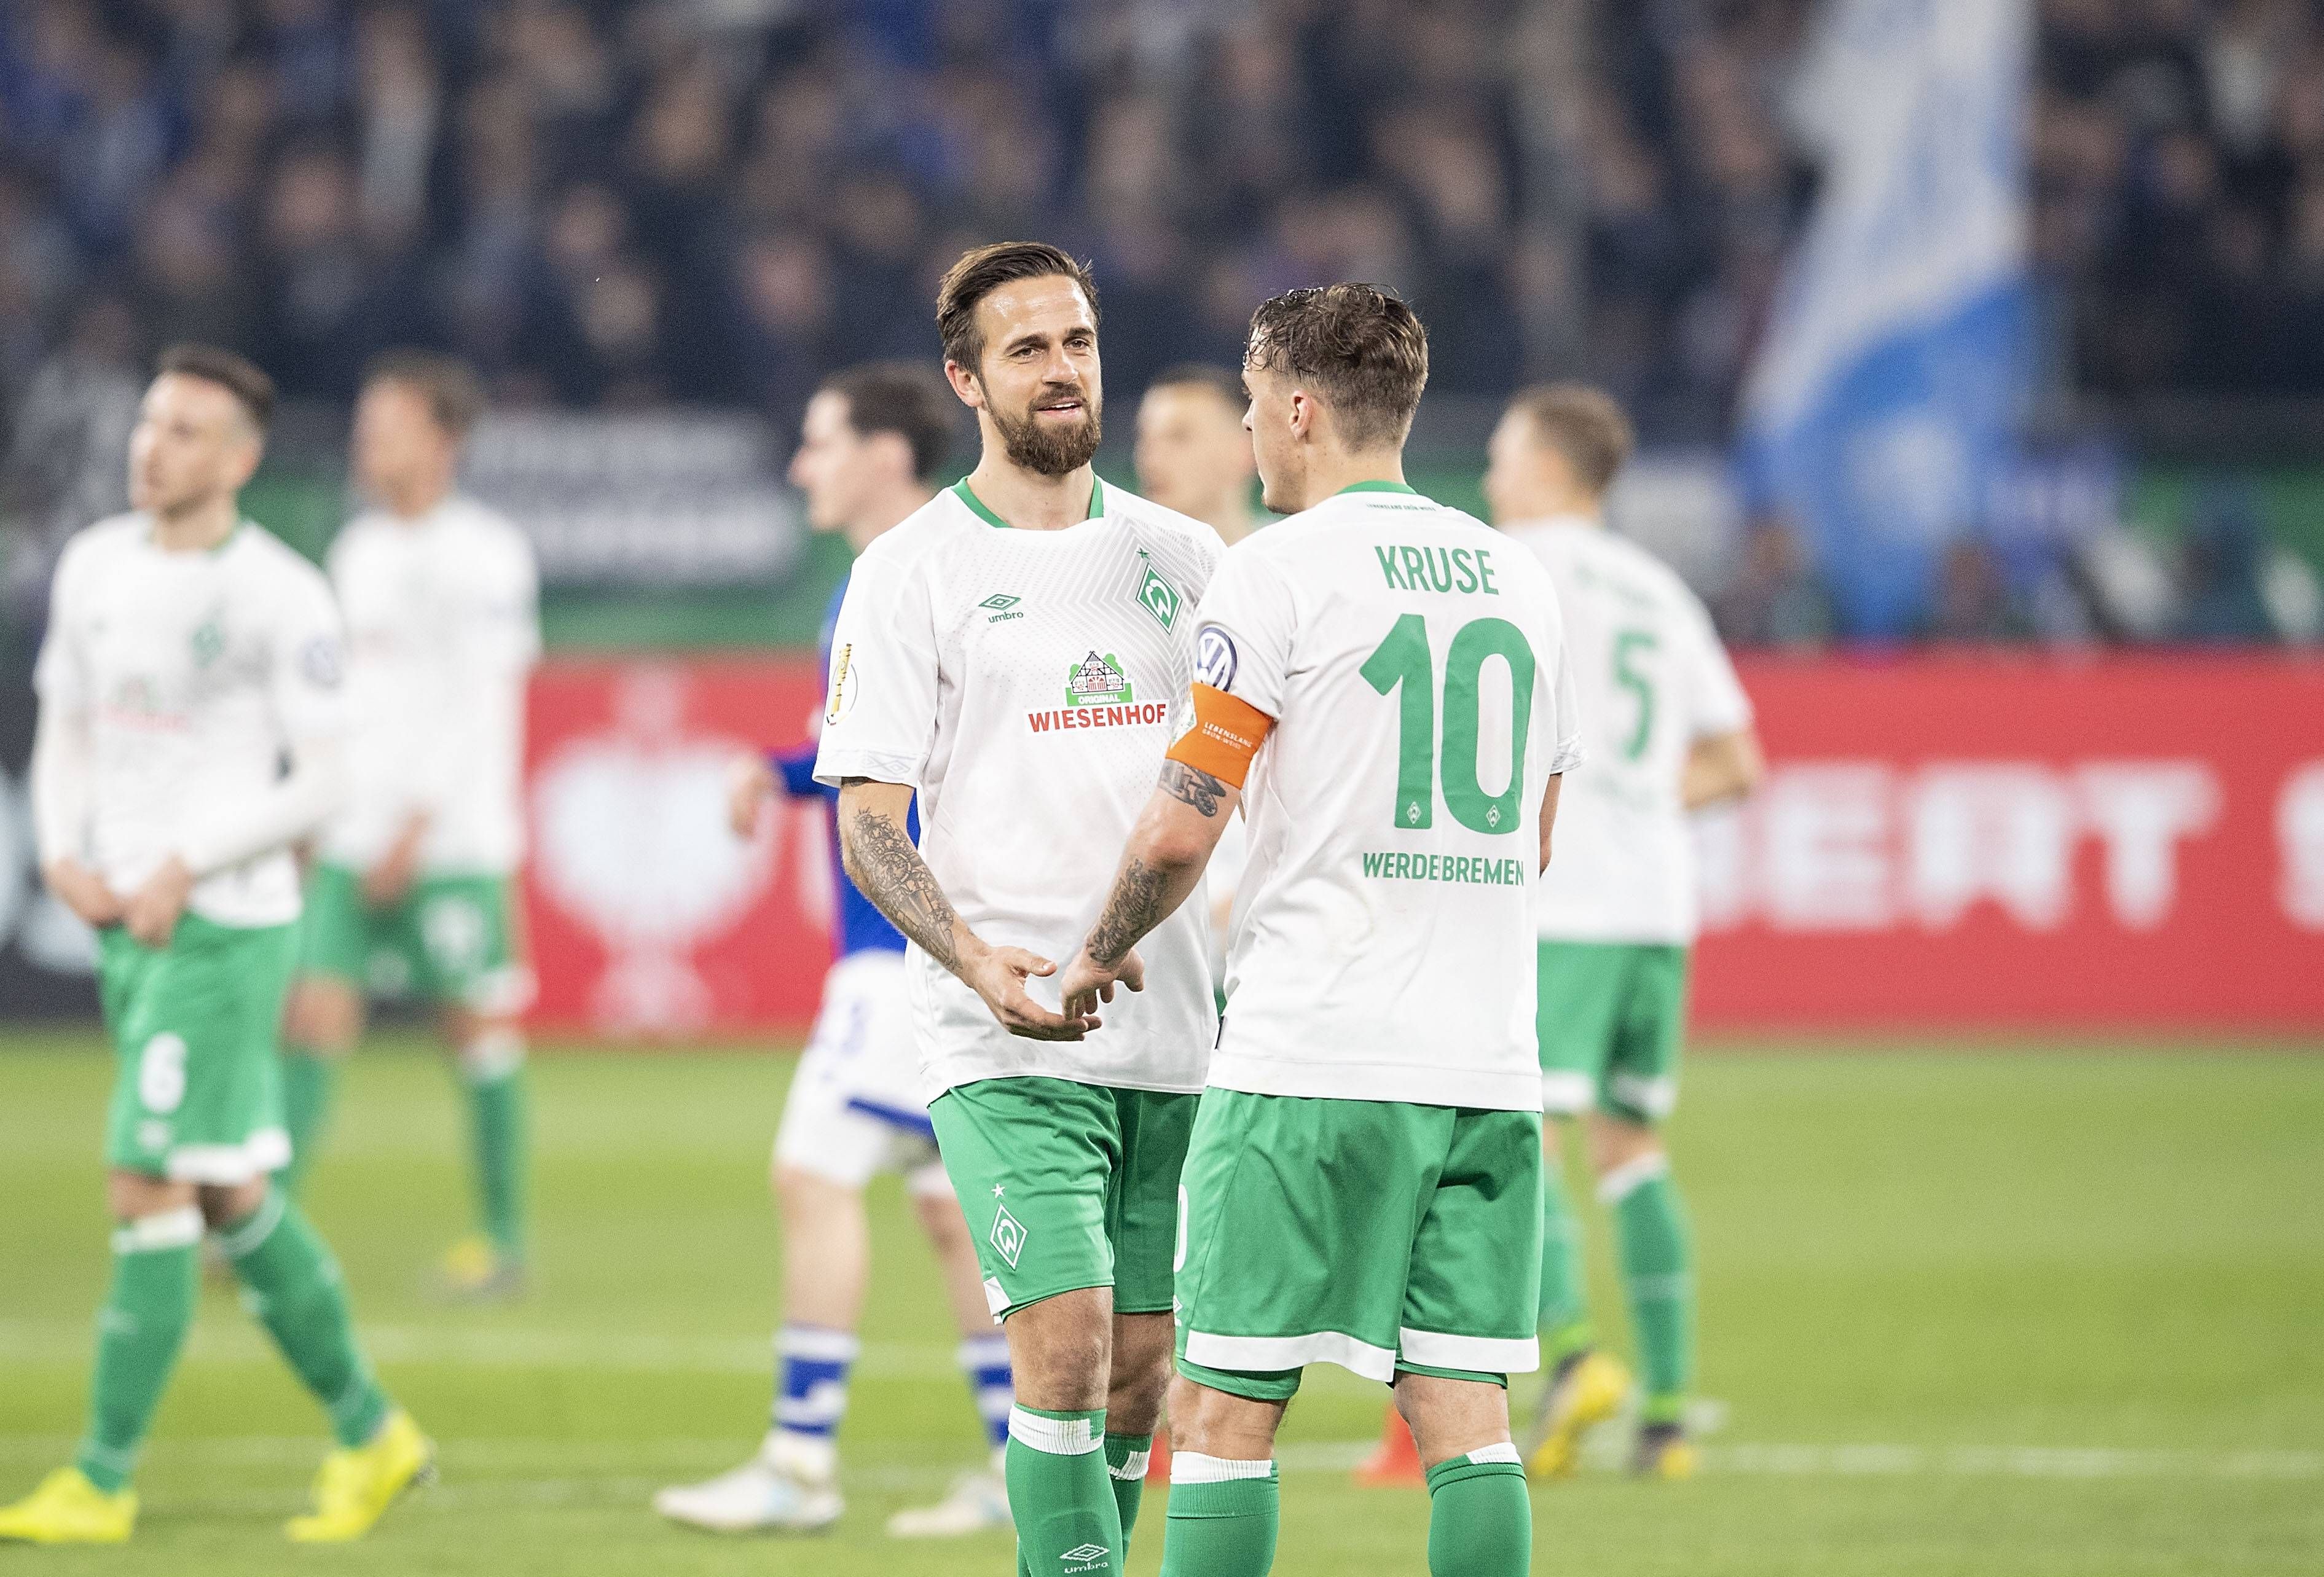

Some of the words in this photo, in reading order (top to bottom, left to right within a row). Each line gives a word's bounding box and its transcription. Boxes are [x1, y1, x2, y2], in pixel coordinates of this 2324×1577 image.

[1375, 545, 1499, 595] KRUSE
[987, 611, 1024, 624] umbro
[1077, 693, 1121, 705] ORIGINAL
[1611, 627, 1662, 764] 5
[1028, 703, 1166, 733] WIESENHOF
[1359, 613, 1536, 835] 10
[139, 1031, 187, 1114] 6
[1064, 1561, 1109, 1574] umbro
